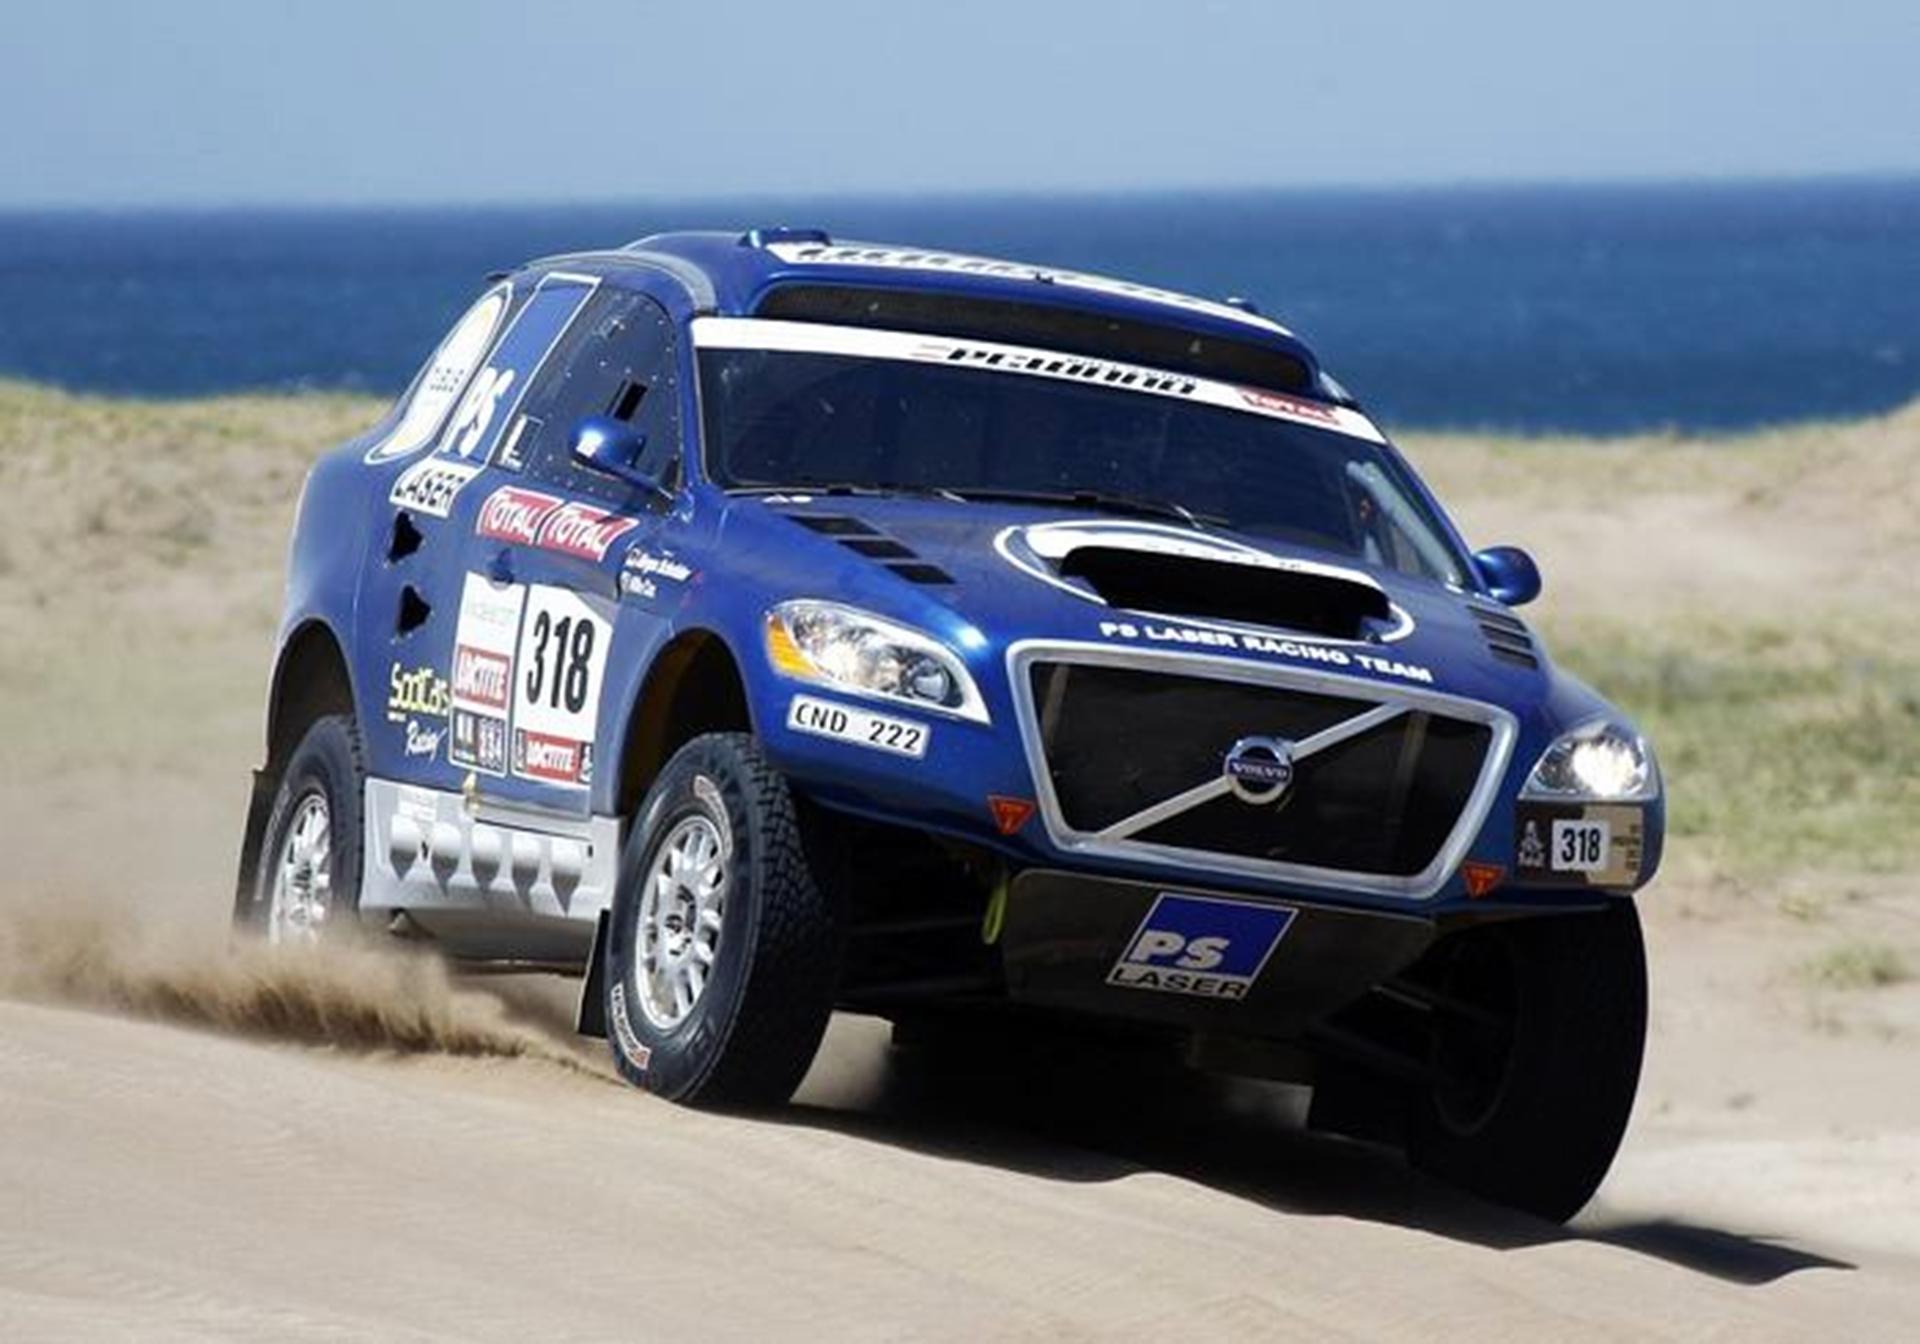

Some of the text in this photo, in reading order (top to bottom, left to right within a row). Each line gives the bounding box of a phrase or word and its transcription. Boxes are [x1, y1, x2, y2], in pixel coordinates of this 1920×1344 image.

[440, 366, 515, 458] PS
[489, 493, 540, 542] TOTAL
[548, 506, 612, 553] TOTAL
[527, 610, 595, 714] 318
[1100, 621, 1434, 684] PS LASER RACING TEAM
[795, 702, 921, 753] CND 222
[1231, 762, 1288, 778] VOLVO
[1562, 827, 1601, 863] 318
[1128, 929, 1231, 970] PS
[1113, 967, 1246, 998] LASER
